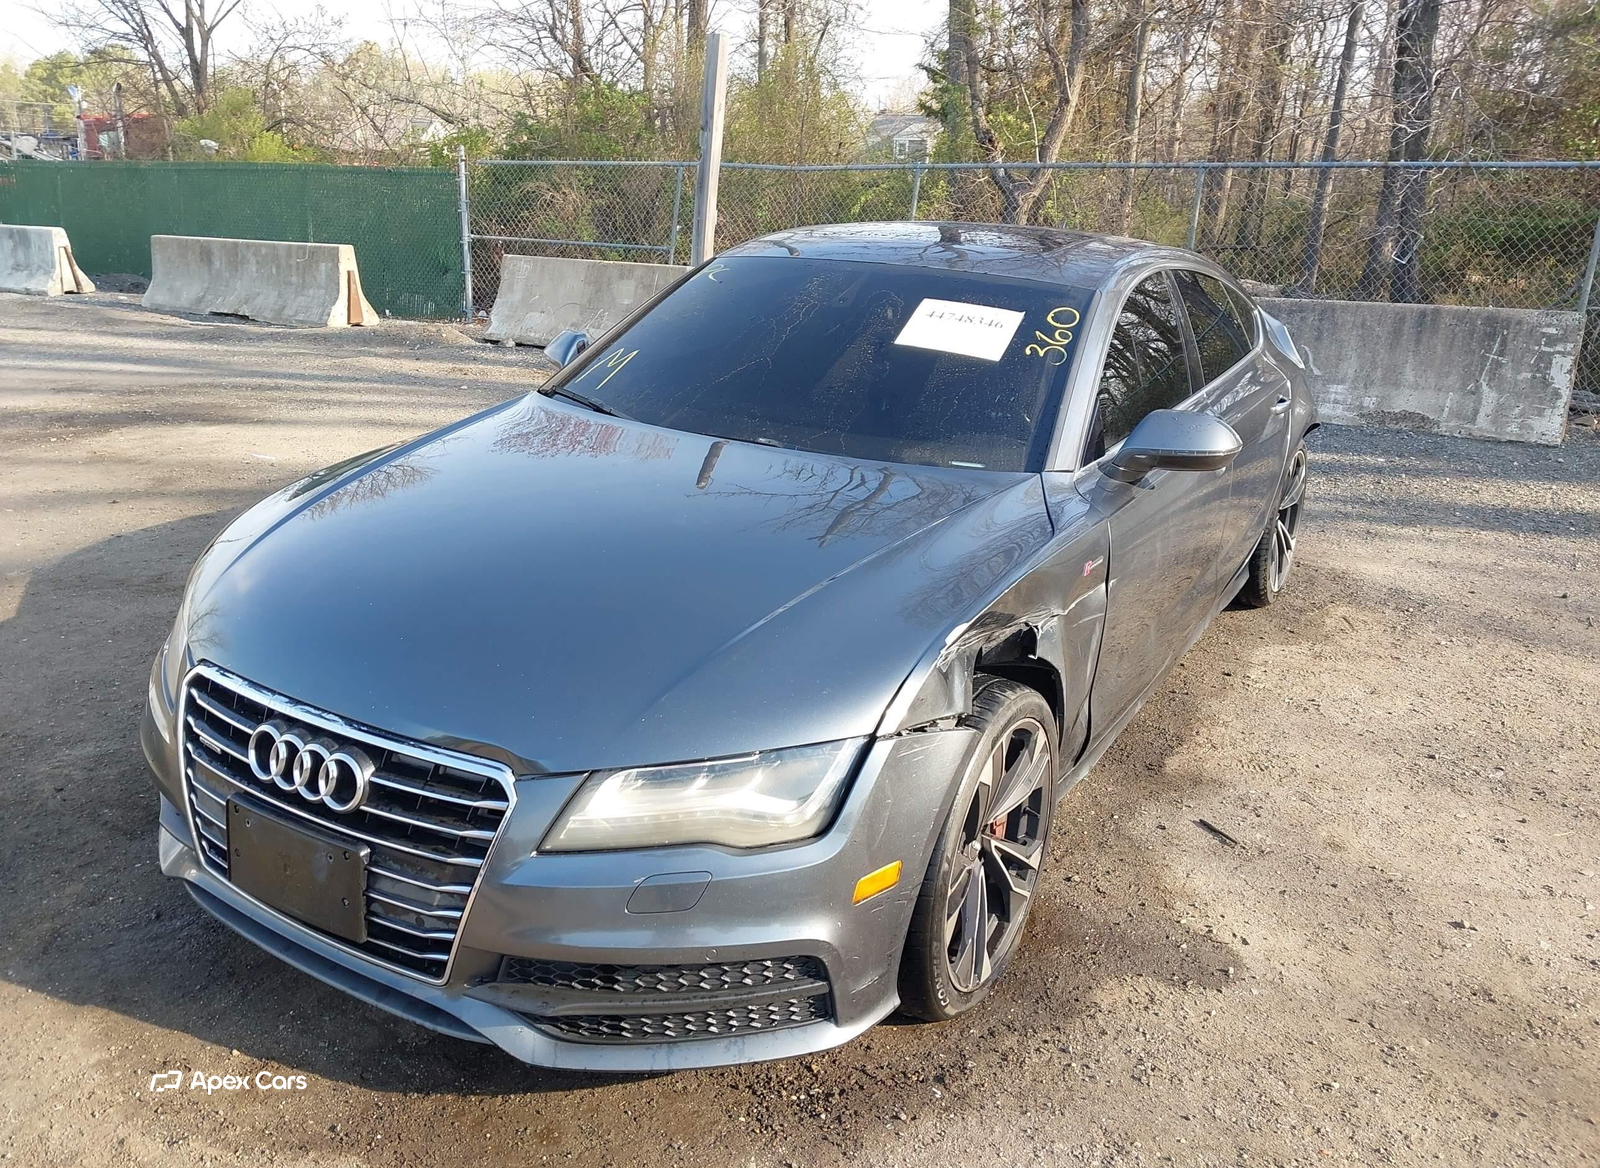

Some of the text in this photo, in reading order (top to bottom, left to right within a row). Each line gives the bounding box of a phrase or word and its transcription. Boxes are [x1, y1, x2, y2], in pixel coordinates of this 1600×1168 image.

[926, 310, 1004, 329] 44748346
[1024, 306, 1081, 366] 360
[574, 347, 640, 391] M
